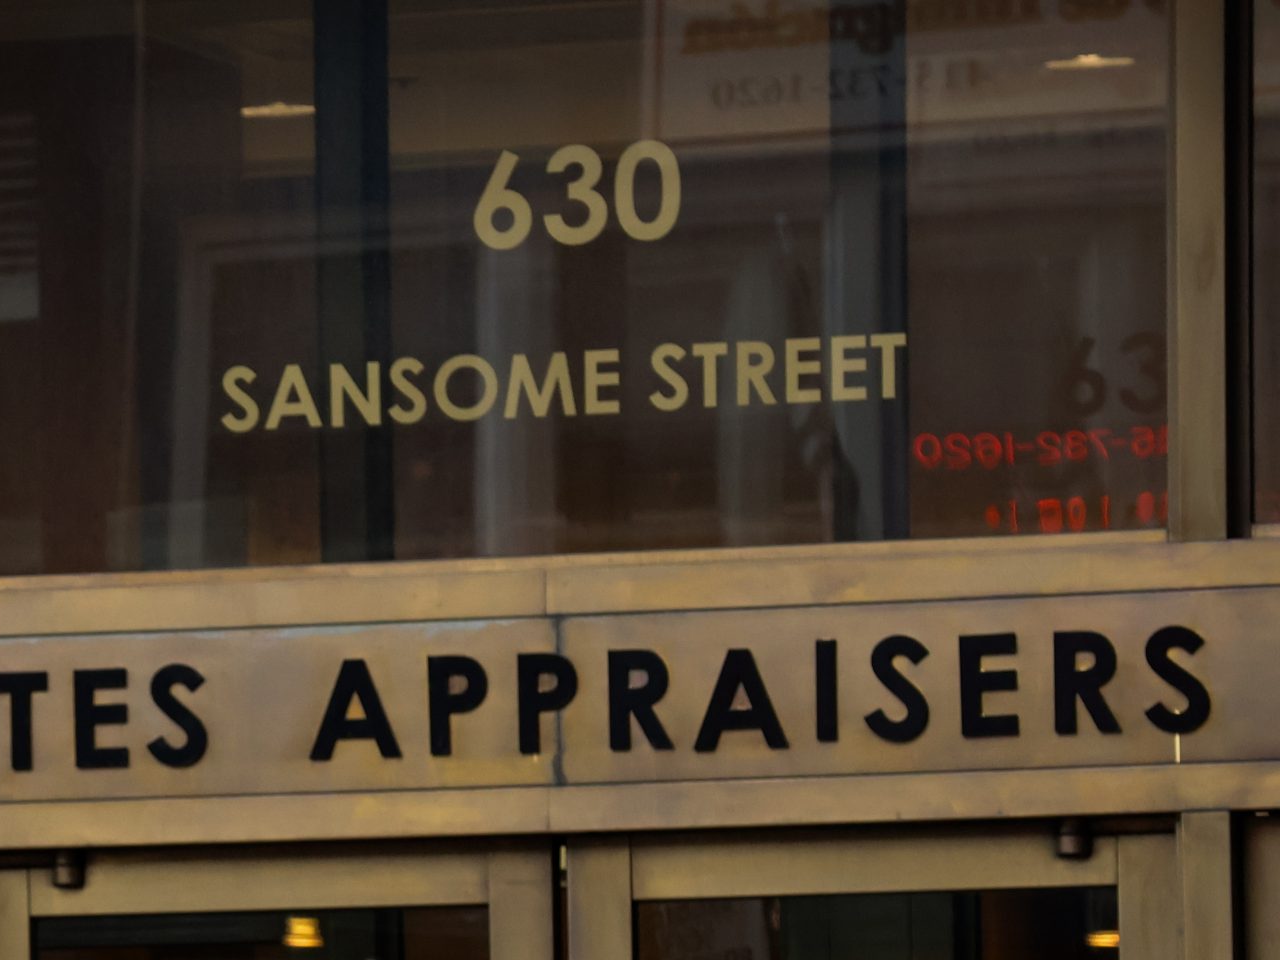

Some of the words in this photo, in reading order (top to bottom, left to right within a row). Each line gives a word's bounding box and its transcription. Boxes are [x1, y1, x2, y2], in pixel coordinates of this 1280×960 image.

[473, 140, 682, 250] 630
[221, 349, 620, 433] SANSOME
[649, 333, 907, 412] STREET
[309, 625, 1211, 761] APPRAISERS
